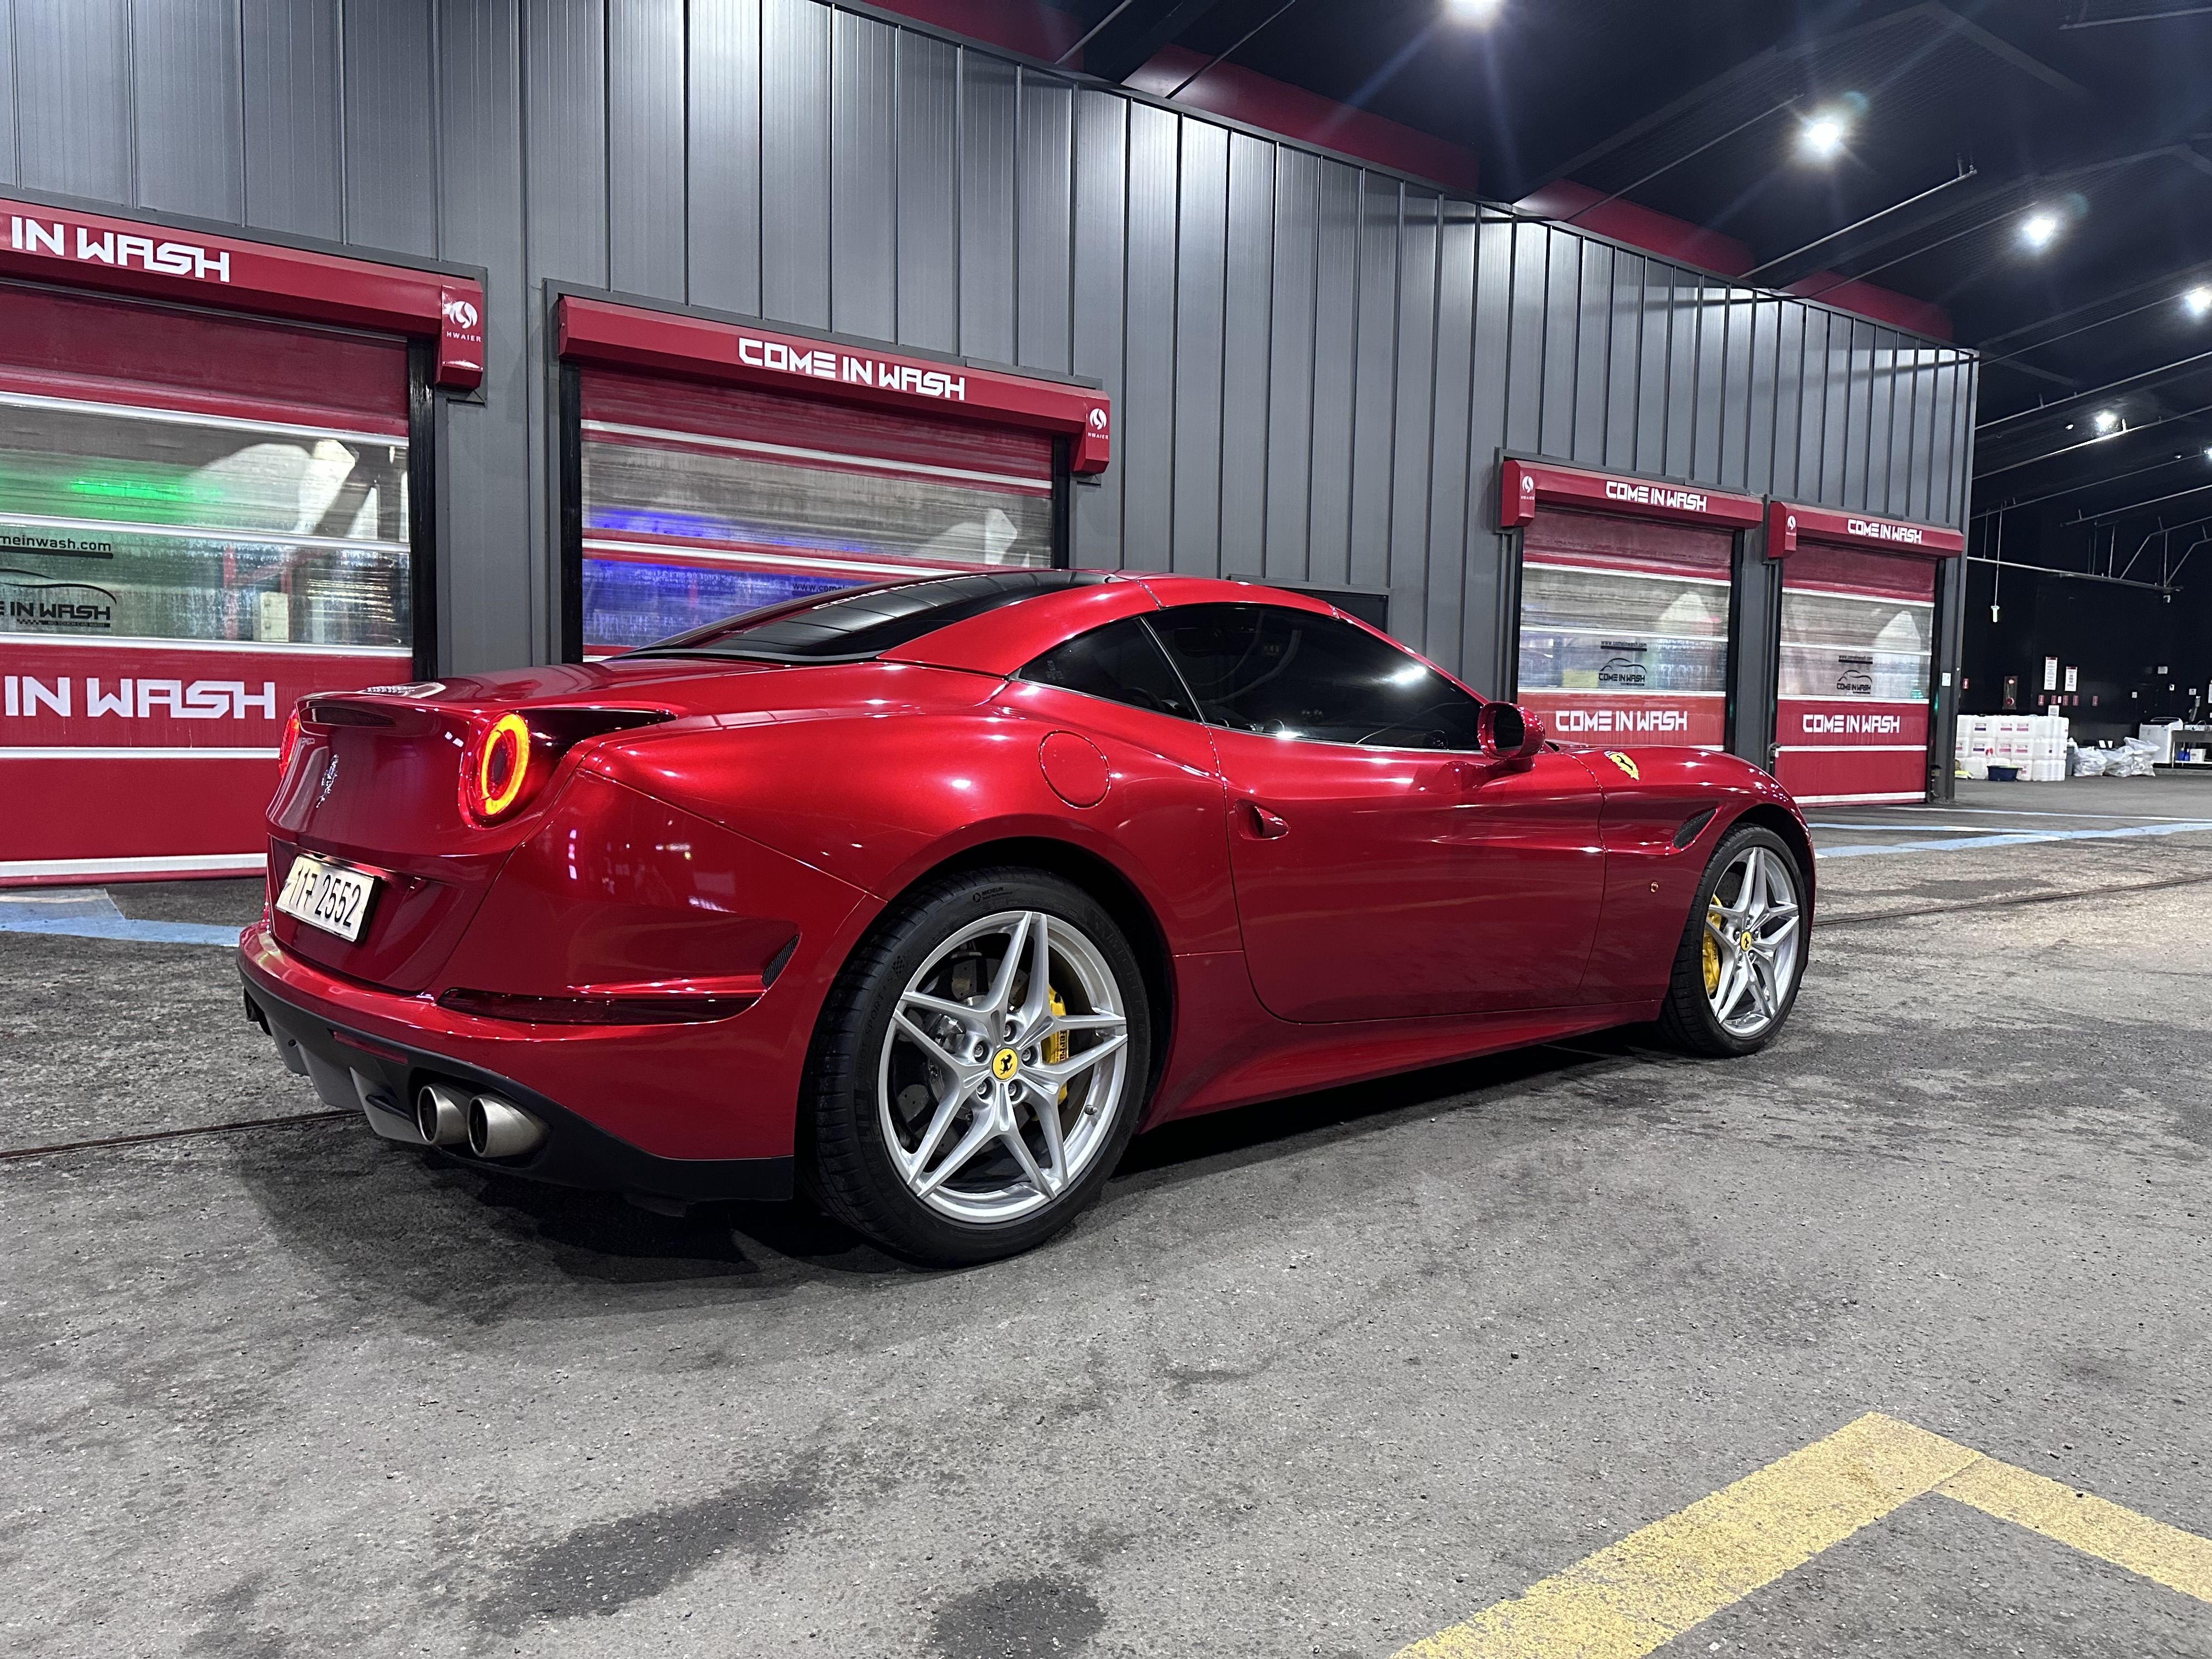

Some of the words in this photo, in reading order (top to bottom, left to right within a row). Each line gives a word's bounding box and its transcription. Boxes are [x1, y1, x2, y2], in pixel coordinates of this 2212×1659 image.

[12, 216, 64, 256] IN
[77, 227, 230, 283] WASH
[446, 331, 482, 342] HWAIER
[738, 337, 836, 379] COME
[843, 356, 872, 385] IN
[879, 363, 965, 400] WASH
[1606, 481, 1649, 504] COME
[1651, 488, 1665, 506] IN
[1666, 490, 1707, 512] WASH
[1847, 518, 1880, 538] COME
[1880, 524, 1892, 540] IN
[1892, 526, 1922, 544] WASH
[10, 601, 34, 618] IN
[40, 603, 110, 620] WASH
[1599, 673, 1618, 681] COME
[1618, 674, 1626, 682] IN
[1626, 674, 1645, 682] WASH
[4, 676, 71, 716] IN
[87, 678, 275, 719] WASH
[1555, 710, 1612, 731] COME
[1615, 710, 1633, 731] IN
[1637, 711, 1688, 731] WASH
[1803, 714, 1844, 733] COME
[1846, 715, 1860, 733] IN
[1861, 715, 1900, 733] WASH
[314, 873, 361, 928] 2552
